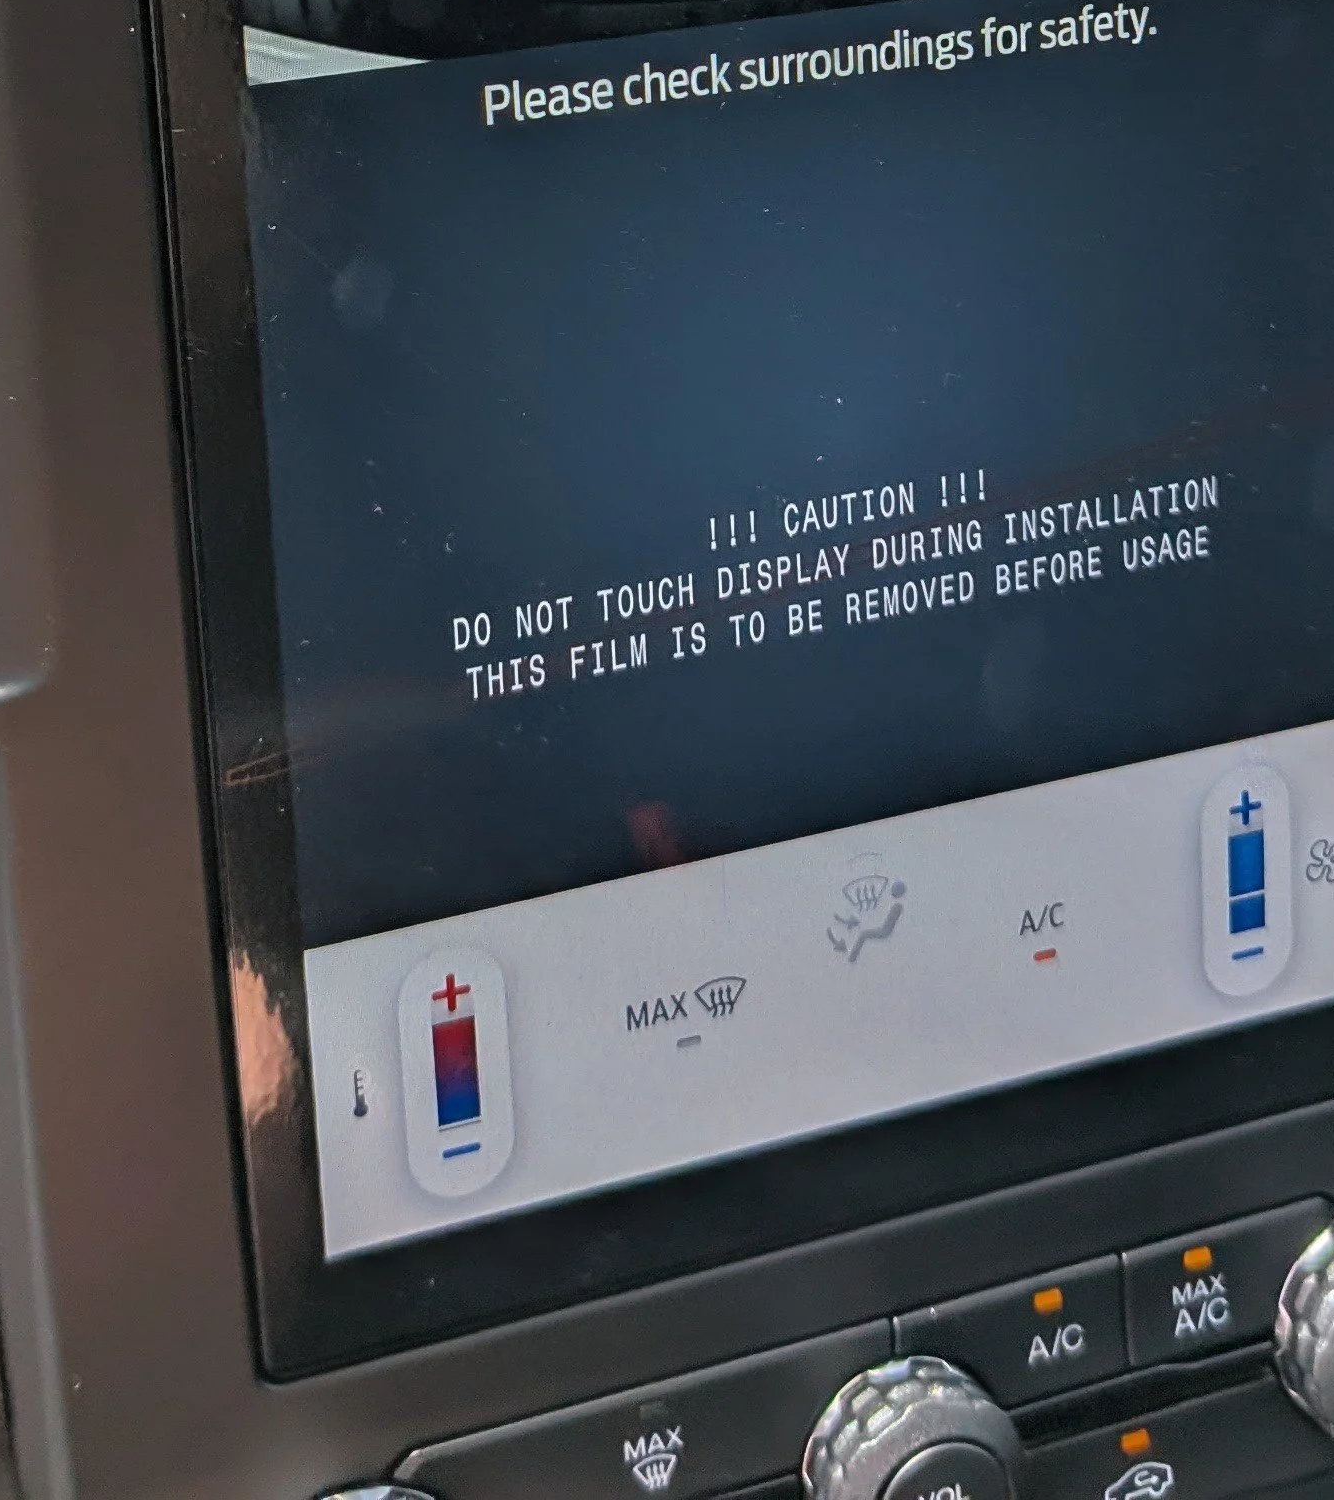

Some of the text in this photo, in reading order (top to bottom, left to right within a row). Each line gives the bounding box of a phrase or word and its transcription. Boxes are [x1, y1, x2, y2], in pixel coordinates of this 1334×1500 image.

[484, 1, 1158, 125] Please check surroundings for safety.
[708, 468, 989, 552] !!! CAUTION !!!
[452, 476, 1219, 652] DO NOT TOUCH DISPLAY DURING INSTALLATION
[466, 524, 1212, 702] THIS FILM IS TO BE REMOVED BEFORE USAGE
[1019, 901, 1066, 936] A/C
[626, 991, 689, 1031] MAX
[1171, 1272, 1226, 1307] MAX
[1173, 1296, 1231, 1339] A/C
[1027, 1322, 1087, 1365] A/C
[623, 1425, 685, 1464] MAX
